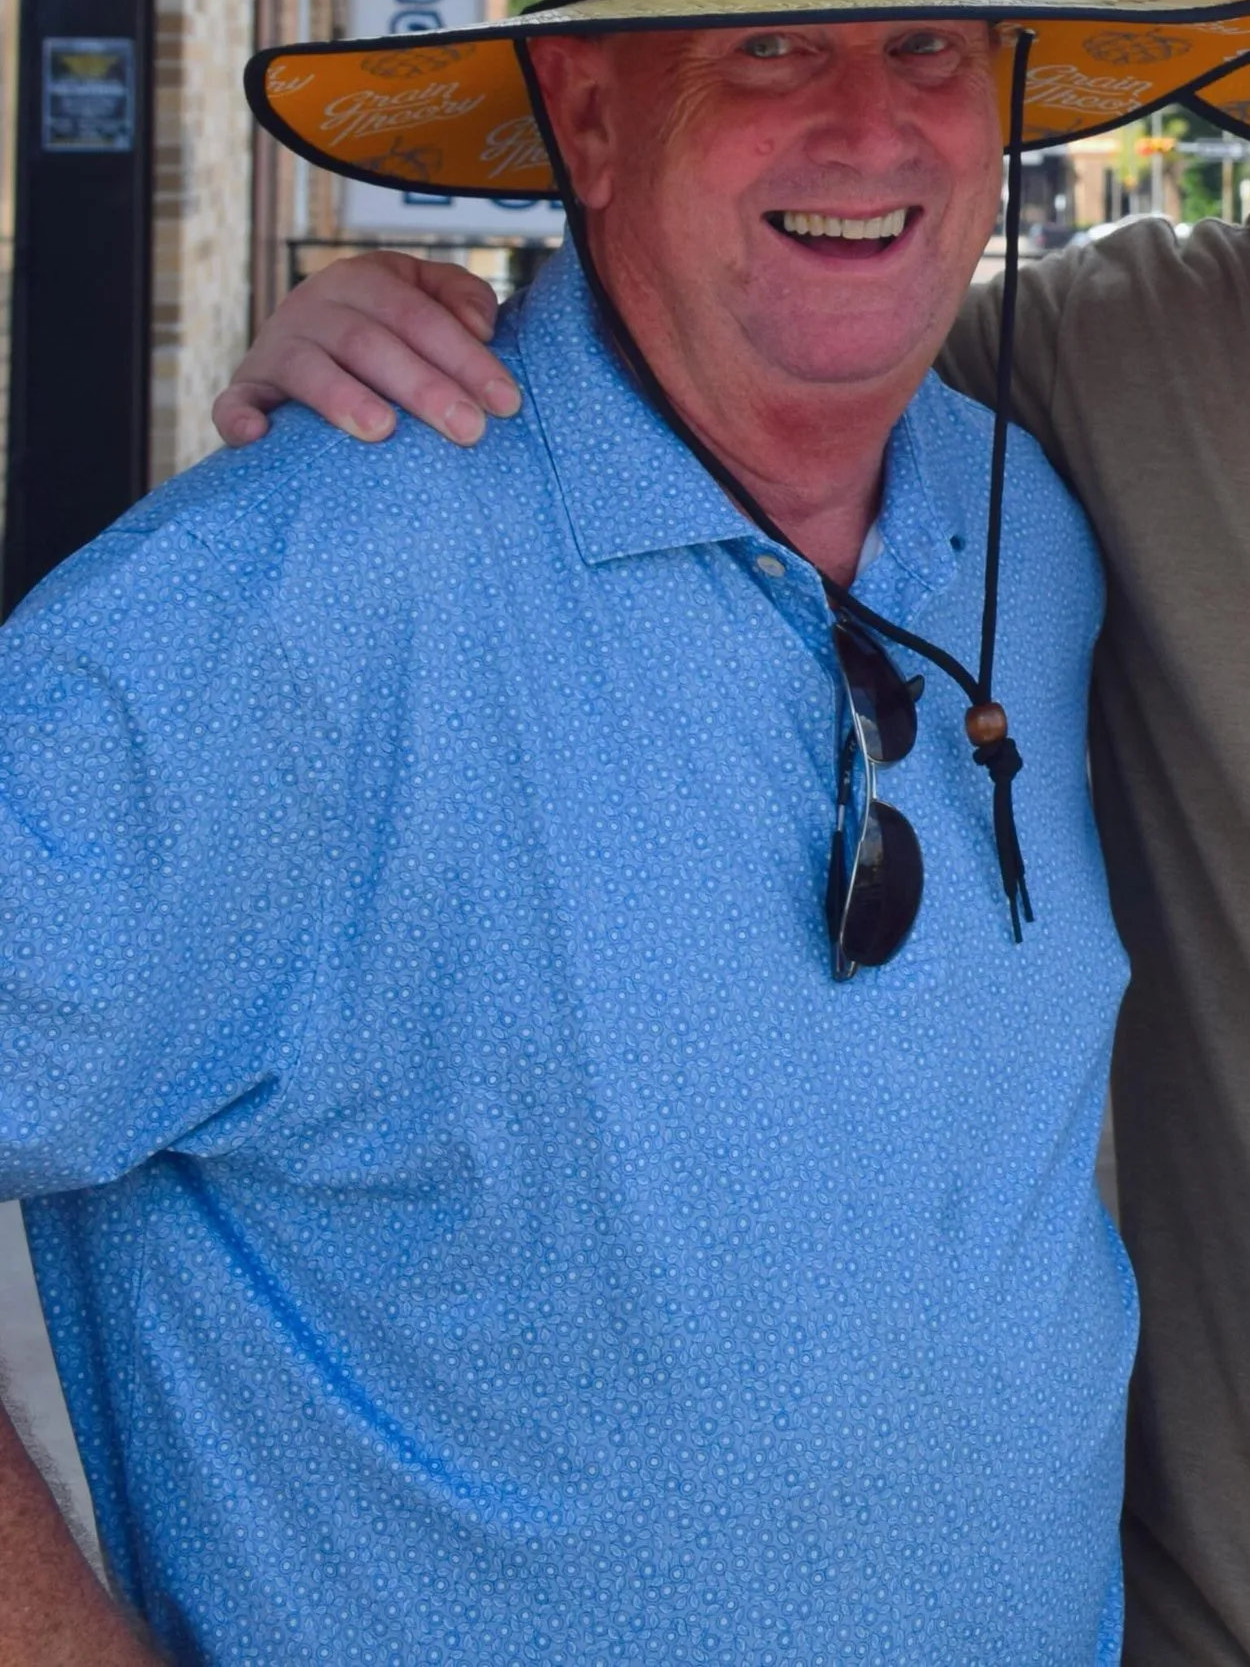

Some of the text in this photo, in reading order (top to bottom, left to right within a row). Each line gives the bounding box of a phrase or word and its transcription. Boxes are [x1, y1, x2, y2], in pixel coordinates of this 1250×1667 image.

[1022, 84, 1145, 117] Theor
[1025, 63, 1154, 97] Grain
[320, 81, 461, 132] Grain
[327, 92, 487, 148] Theory
